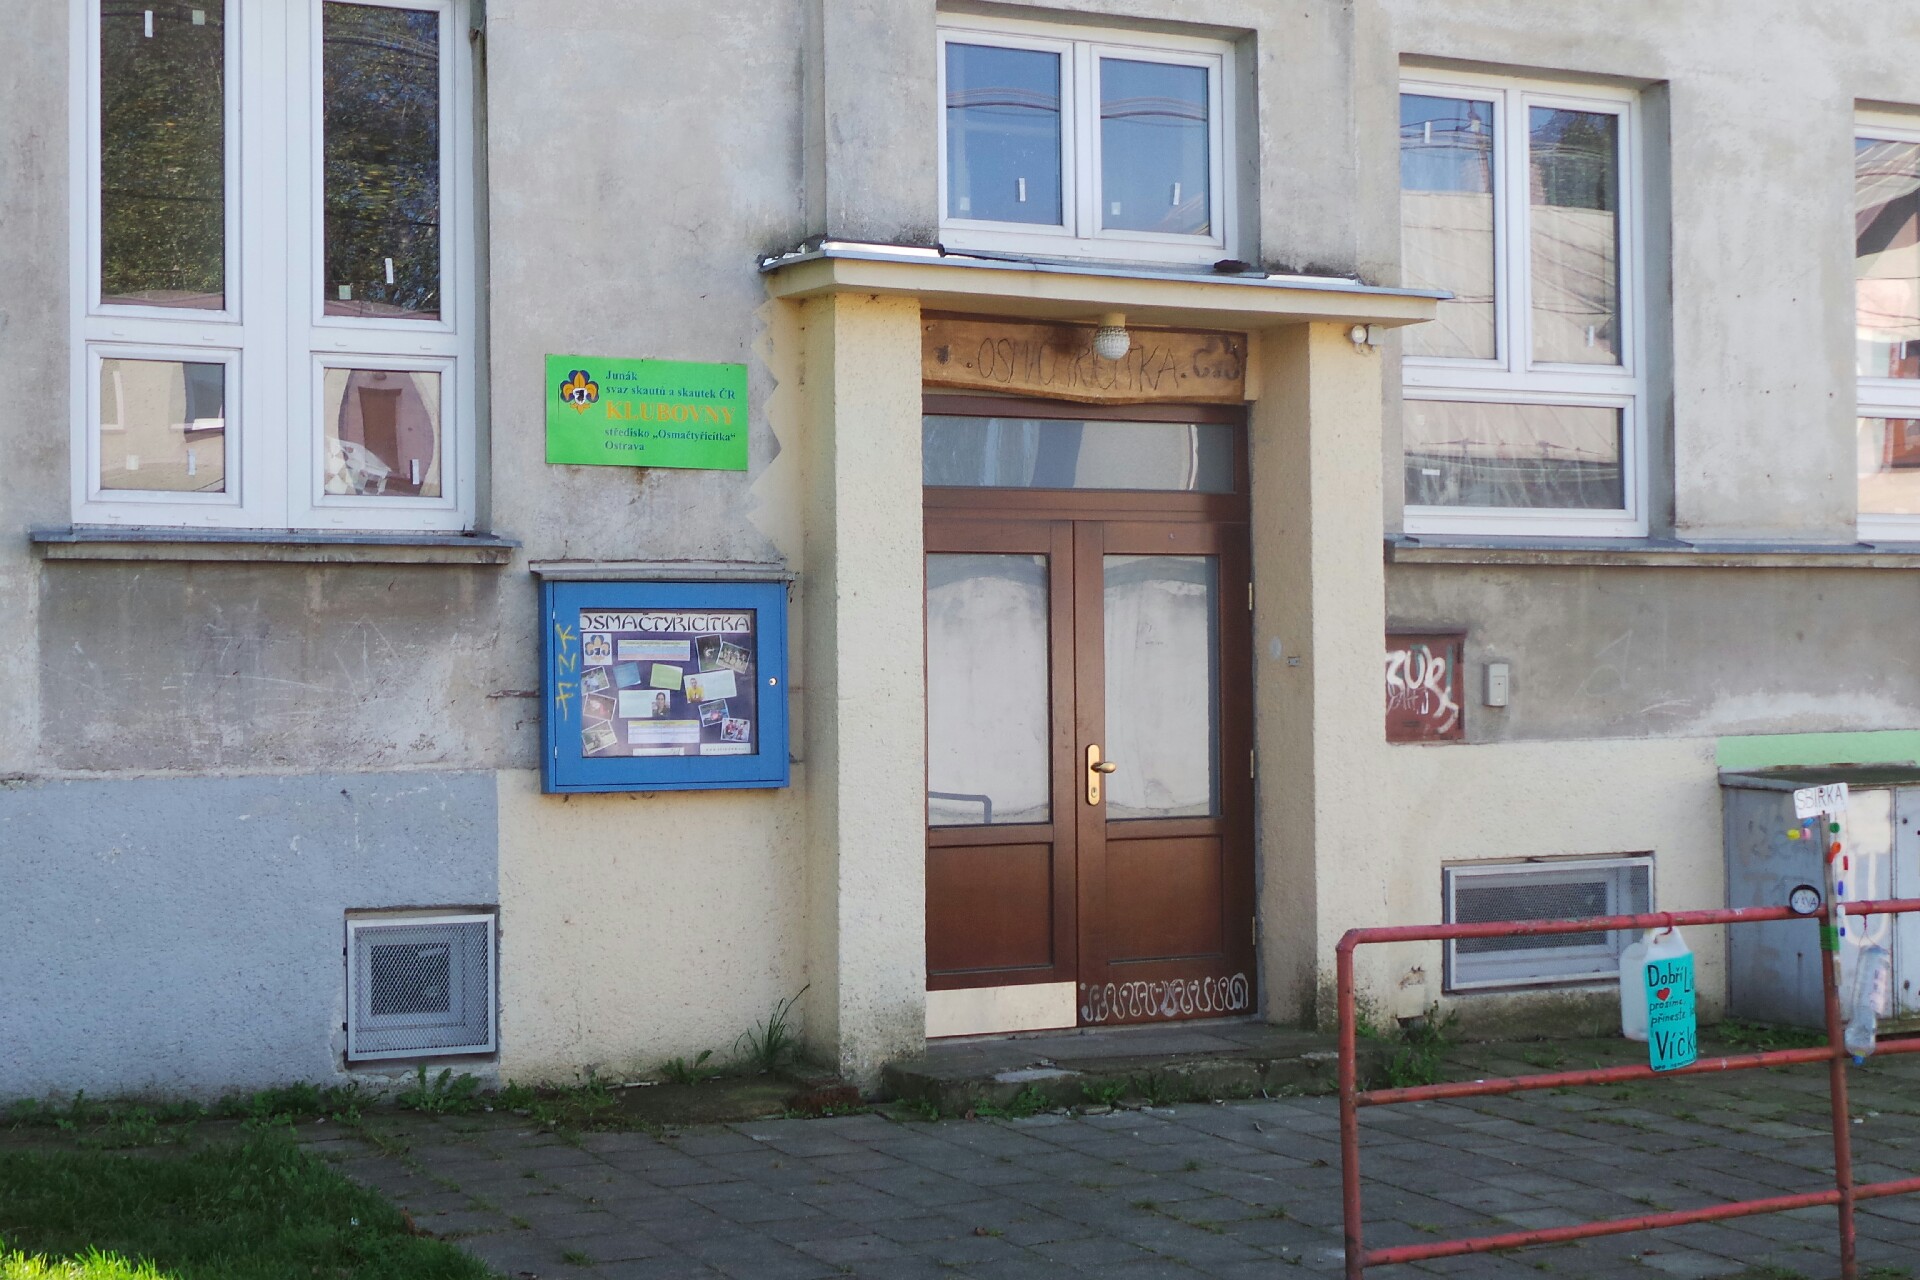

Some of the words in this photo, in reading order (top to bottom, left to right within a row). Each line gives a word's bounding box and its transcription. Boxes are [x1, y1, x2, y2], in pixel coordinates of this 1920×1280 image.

[605, 369, 638, 381] Junák
[605, 386, 629, 394] svaz
[631, 385, 666, 396] skautů
[668, 389, 676, 397] a
[678, 387, 716, 399] skautek
[719, 386, 736, 400] ČR
[605, 401, 736, 425] KLUBOVNY
[604, 427, 650, 438] středisko
[604, 441, 645, 451] Ostrava
[1647, 963, 1684, 987] Dobří
